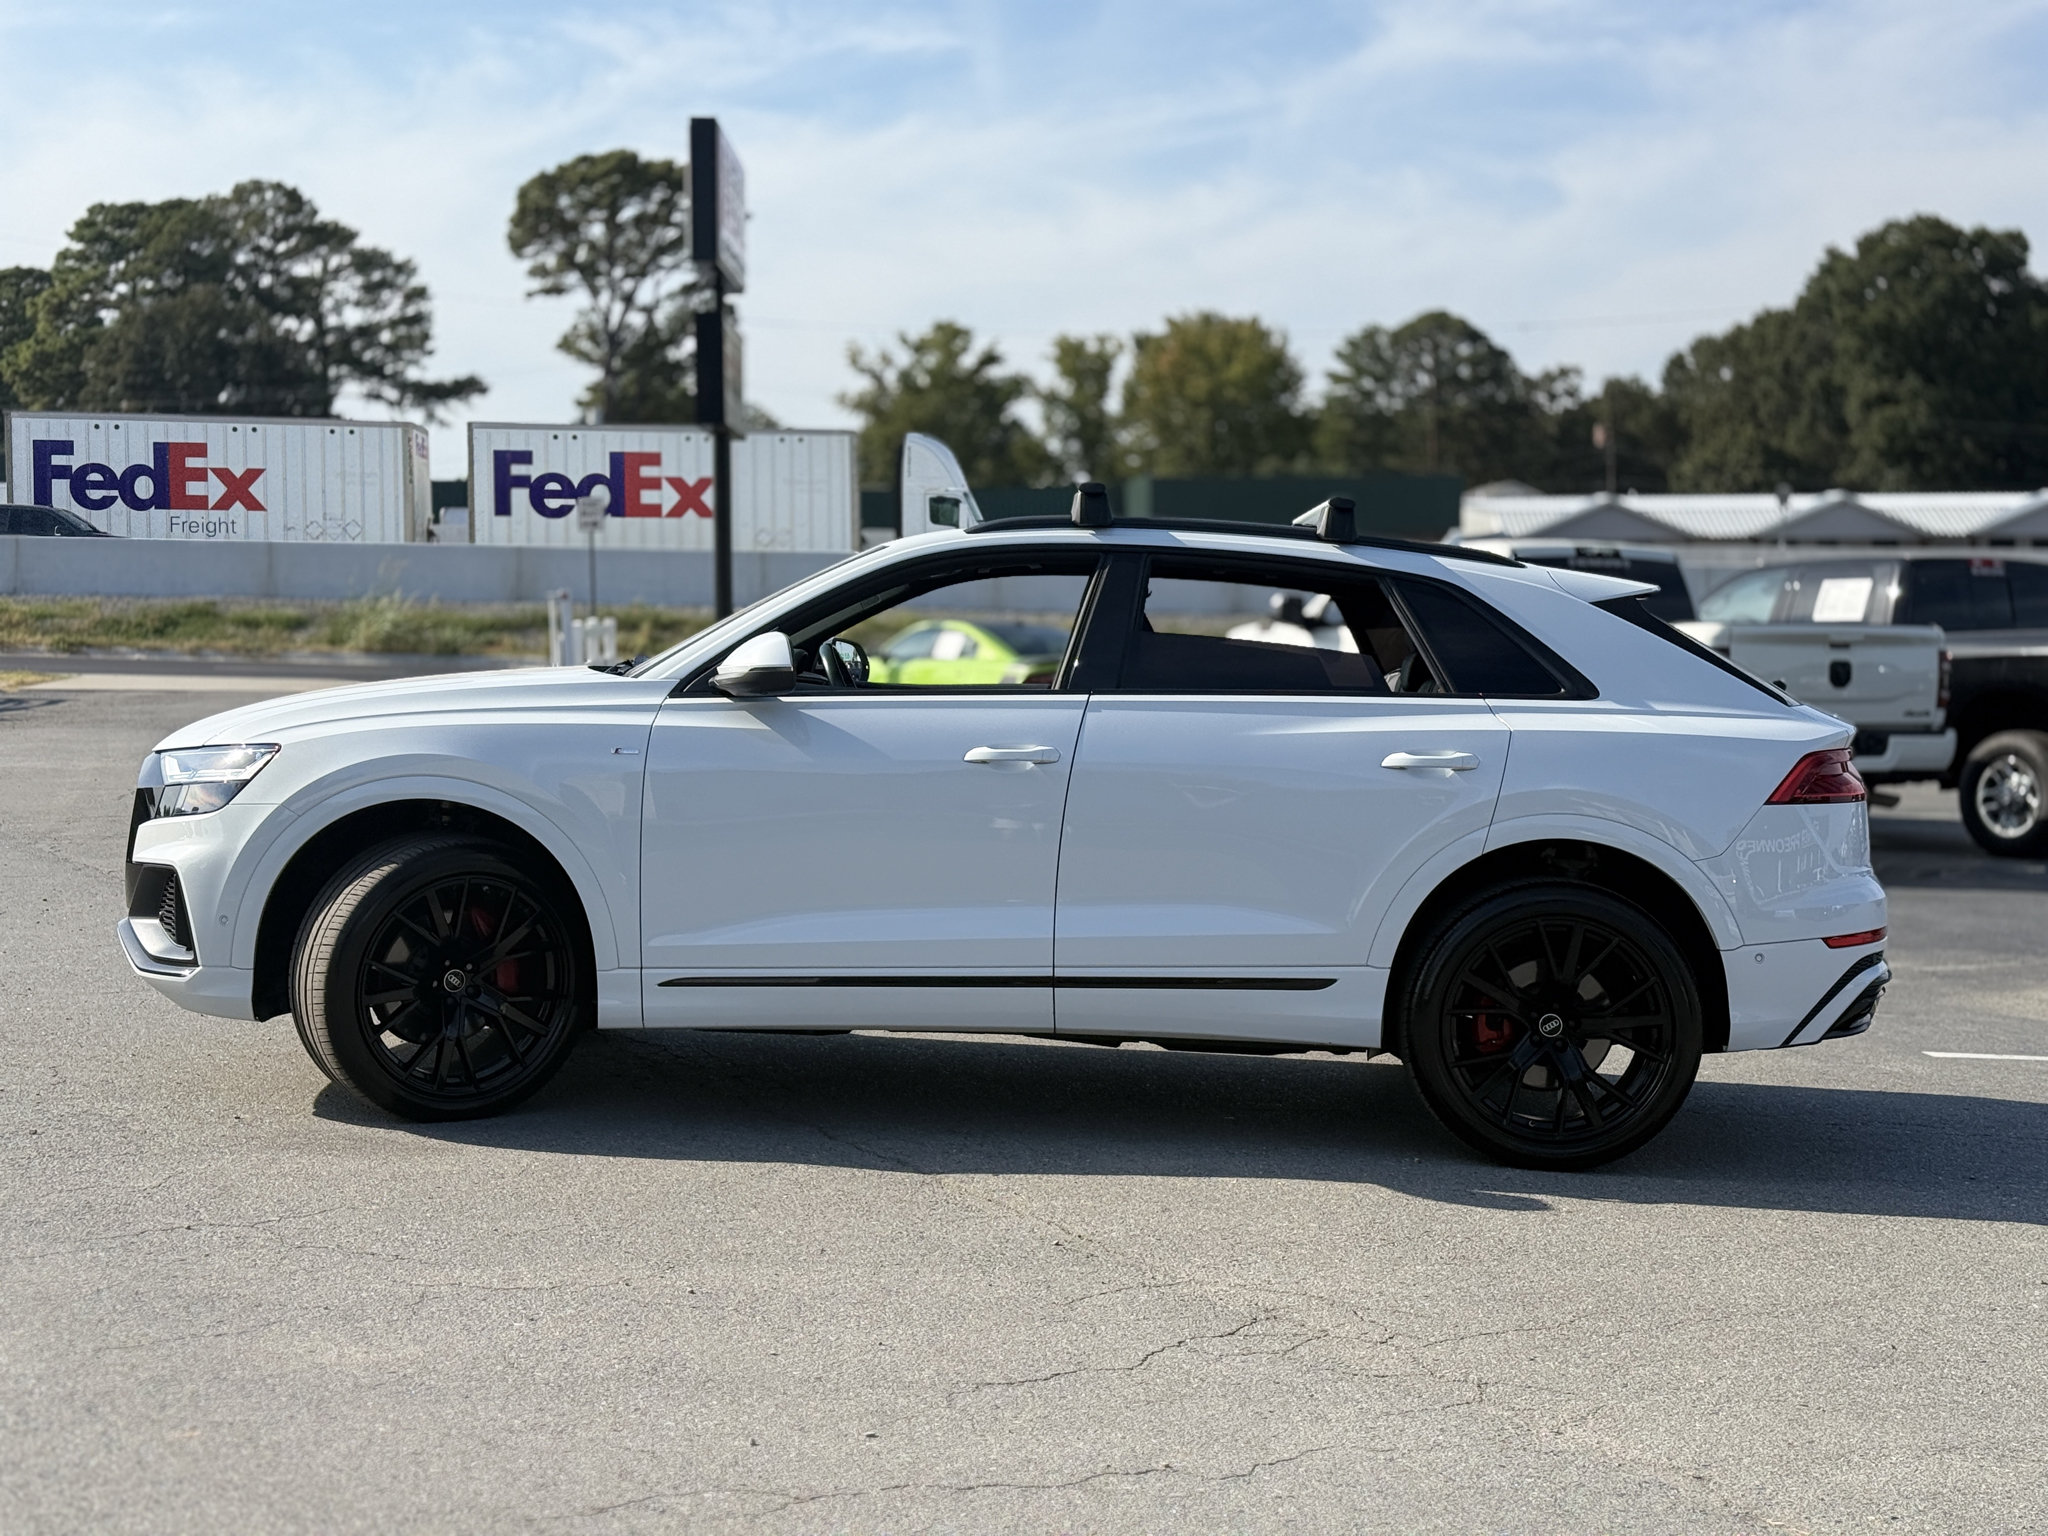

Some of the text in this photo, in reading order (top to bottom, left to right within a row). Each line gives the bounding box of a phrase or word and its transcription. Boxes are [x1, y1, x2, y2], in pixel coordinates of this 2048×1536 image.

[33, 440, 267, 511] FedEx
[493, 450, 713, 517] FedEx
[170, 516, 237, 537] Freight
